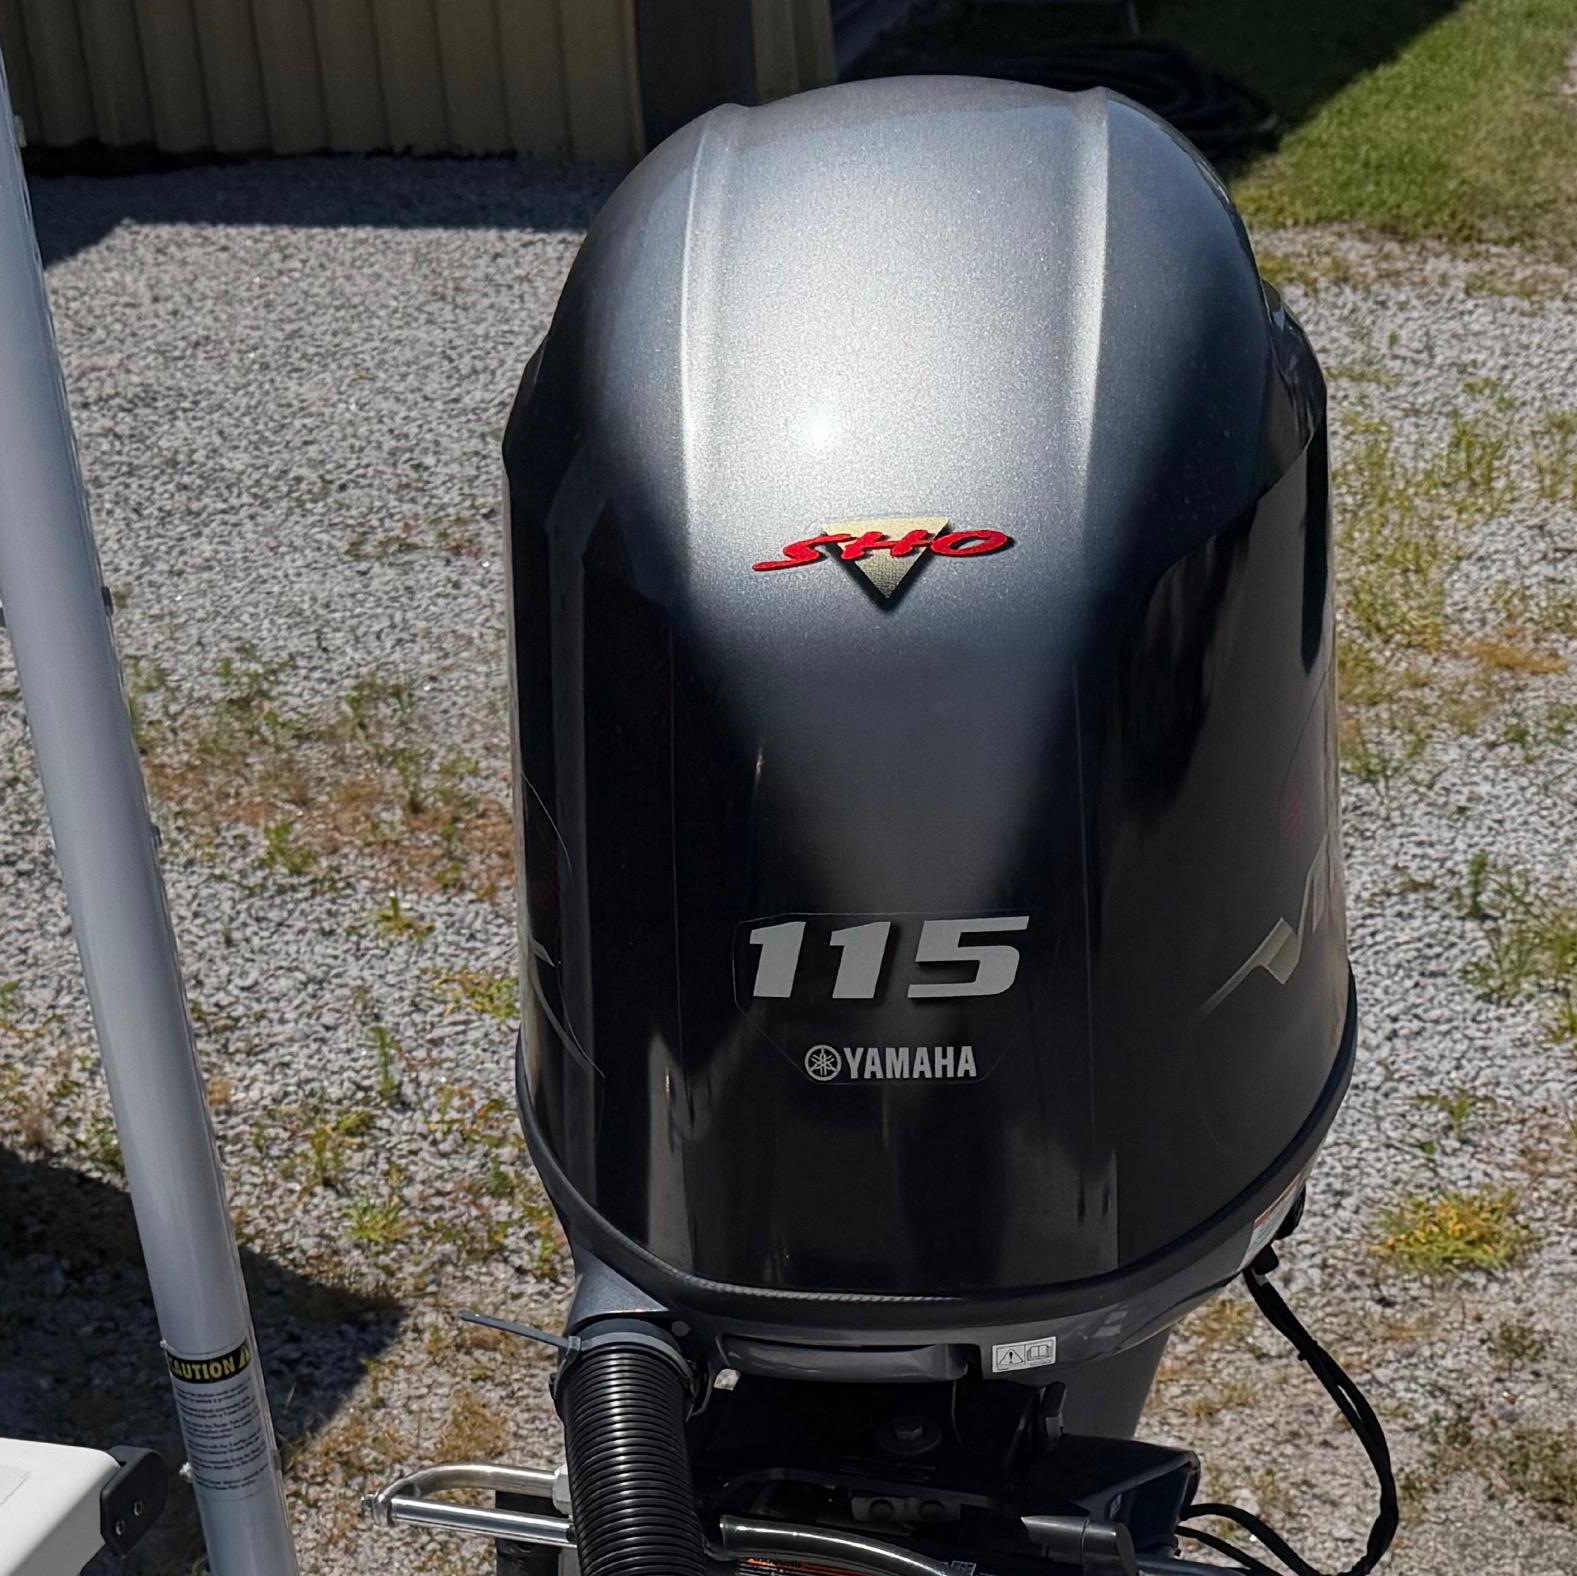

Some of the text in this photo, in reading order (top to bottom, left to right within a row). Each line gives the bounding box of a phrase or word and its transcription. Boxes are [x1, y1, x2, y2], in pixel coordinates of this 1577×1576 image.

[752, 530, 1011, 571] SHO
[749, 916, 1030, 999] 115
[844, 1046, 977, 1079] YAMAHA
